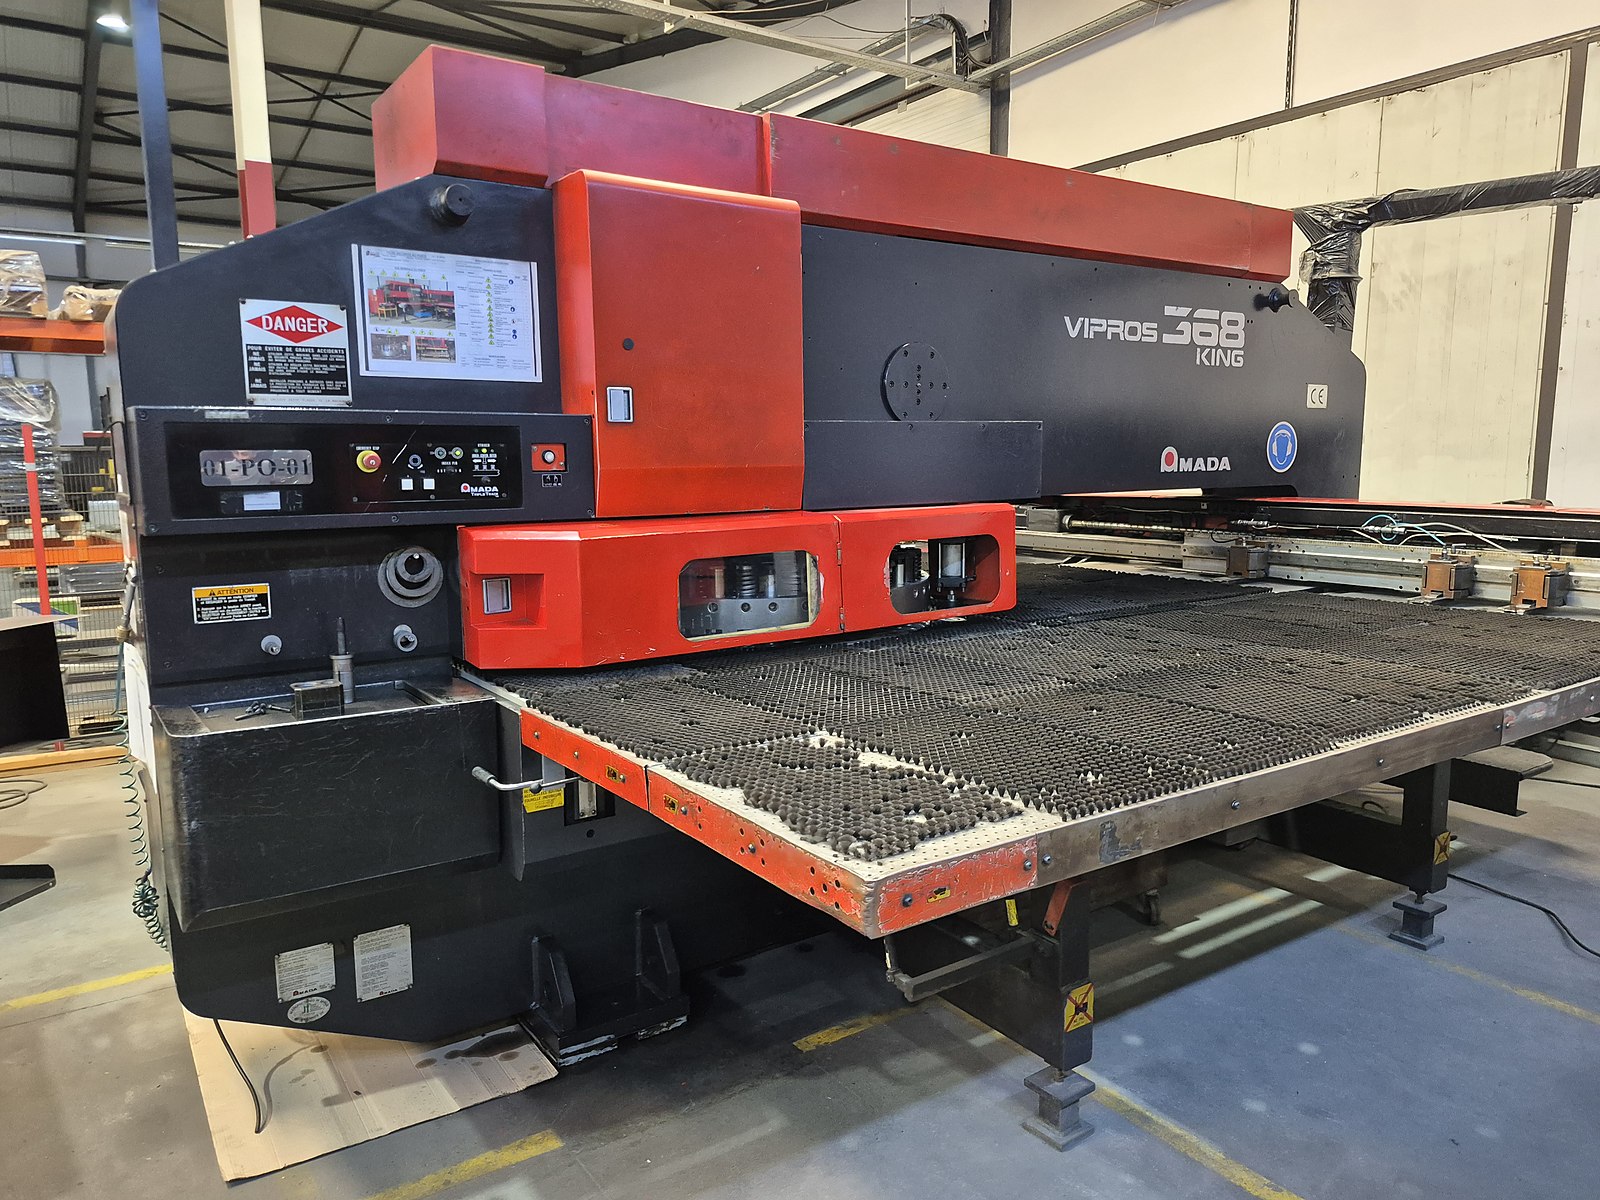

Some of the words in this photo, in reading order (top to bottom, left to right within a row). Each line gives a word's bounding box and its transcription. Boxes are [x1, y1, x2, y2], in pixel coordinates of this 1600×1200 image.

[261, 315, 329, 333] DANGER
[1063, 316, 1158, 343] VIPROS
[1162, 305, 1246, 348] 368
[1195, 347, 1245, 368] KING
[203, 458, 310, 477] 01-PO-01
[1160, 446, 1231, 473] AMADA
[461, 483, 499, 493] AMADA
[217, 588, 254, 596] ATTENTION
